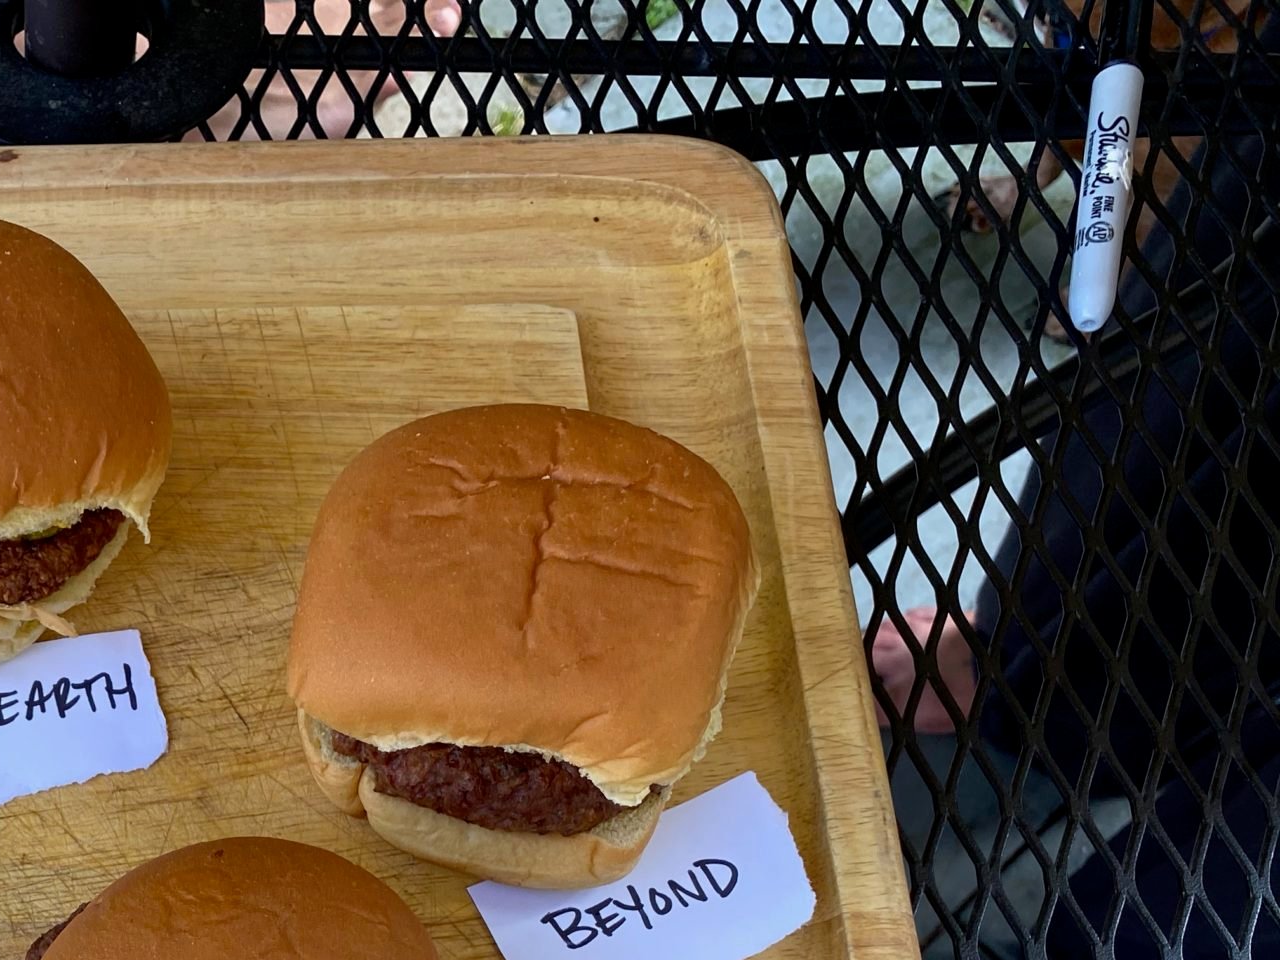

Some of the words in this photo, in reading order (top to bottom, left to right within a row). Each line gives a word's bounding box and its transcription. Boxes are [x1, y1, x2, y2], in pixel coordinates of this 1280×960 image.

[1090, 195, 1103, 219] POINT
[1103, 195, 1115, 213] FINE
[539, 858, 739, 950] BEYOND
